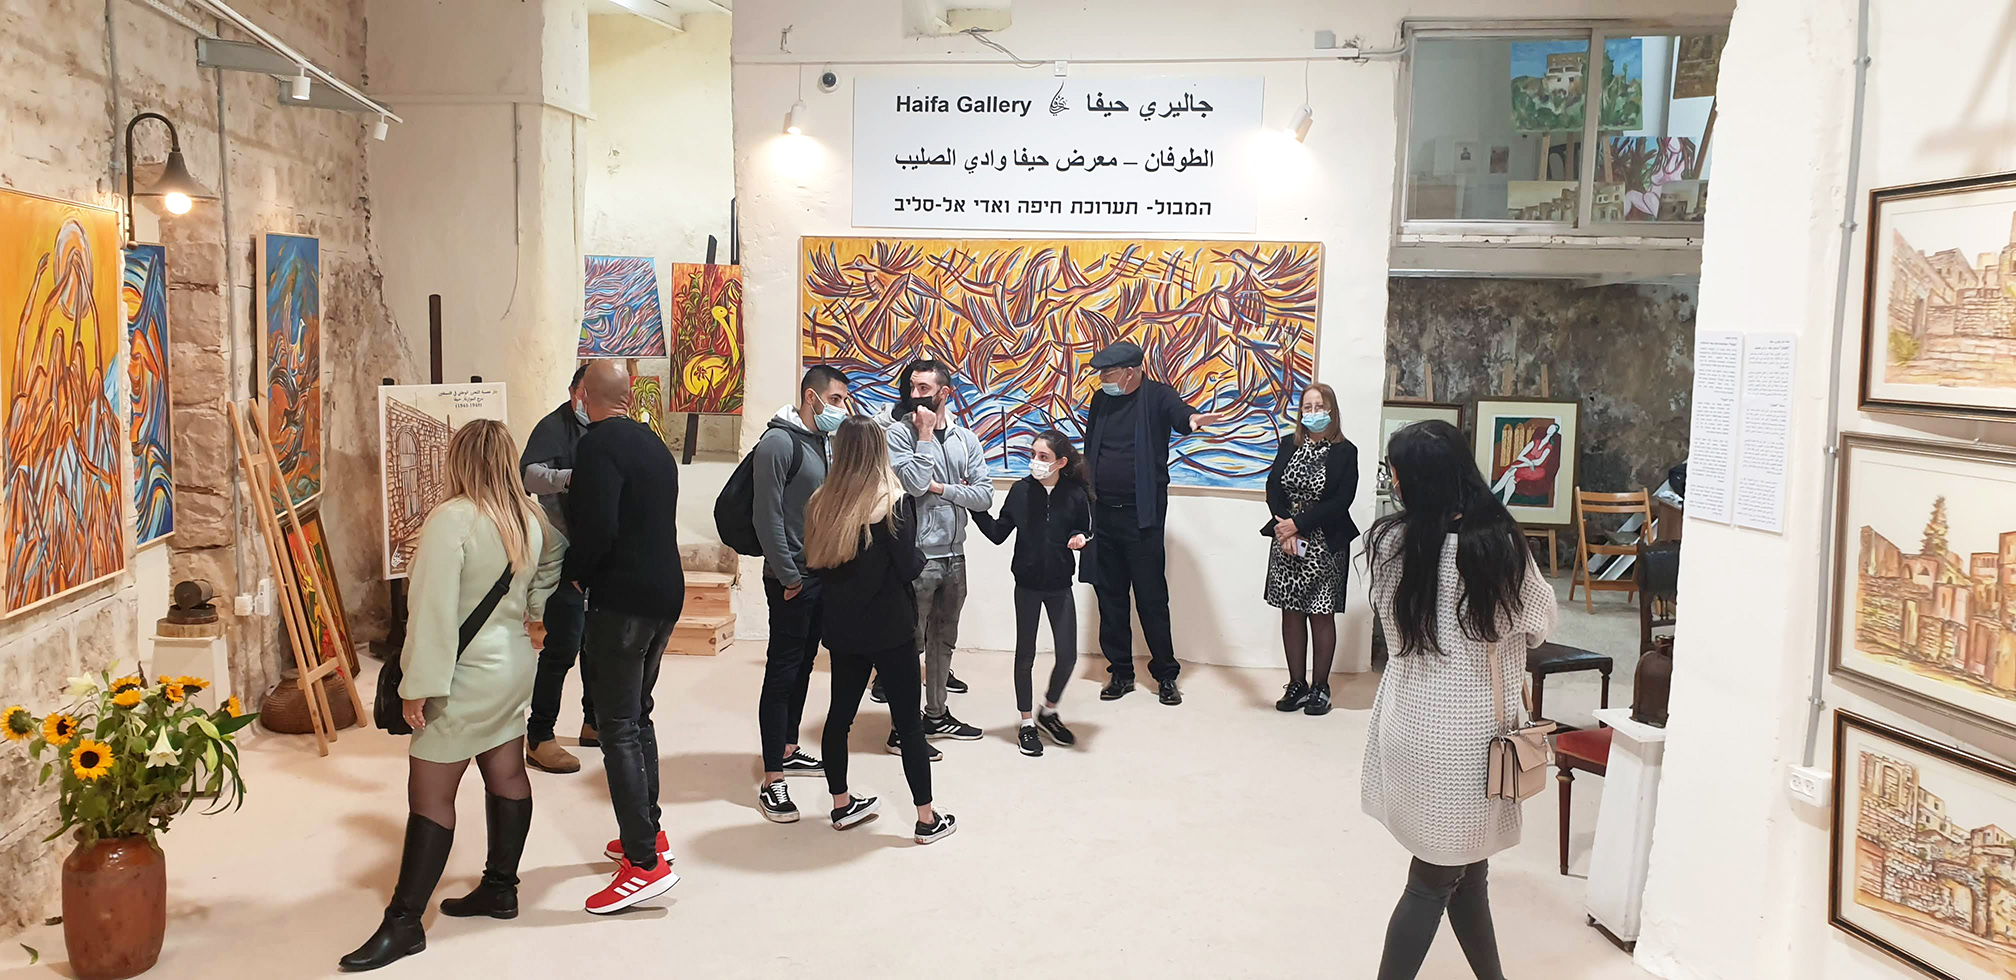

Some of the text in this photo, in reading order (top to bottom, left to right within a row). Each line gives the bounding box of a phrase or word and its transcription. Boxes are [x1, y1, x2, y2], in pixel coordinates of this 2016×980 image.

[896, 95, 1033, 118] Haifa Gallery
[1086, 91, 1214, 122] جاليري حيفا
[894, 146, 956, 171] الصليب
[964, 149, 1007, 175] وادي
[1013, 147, 1050, 172] حيفا
[1055, 149, 1118, 173] معرض
[1144, 146, 1214, 173] الطوفان
[894, 196, 1212, 216] המבול- תערוכת חיפה ואדי אל-סליב
